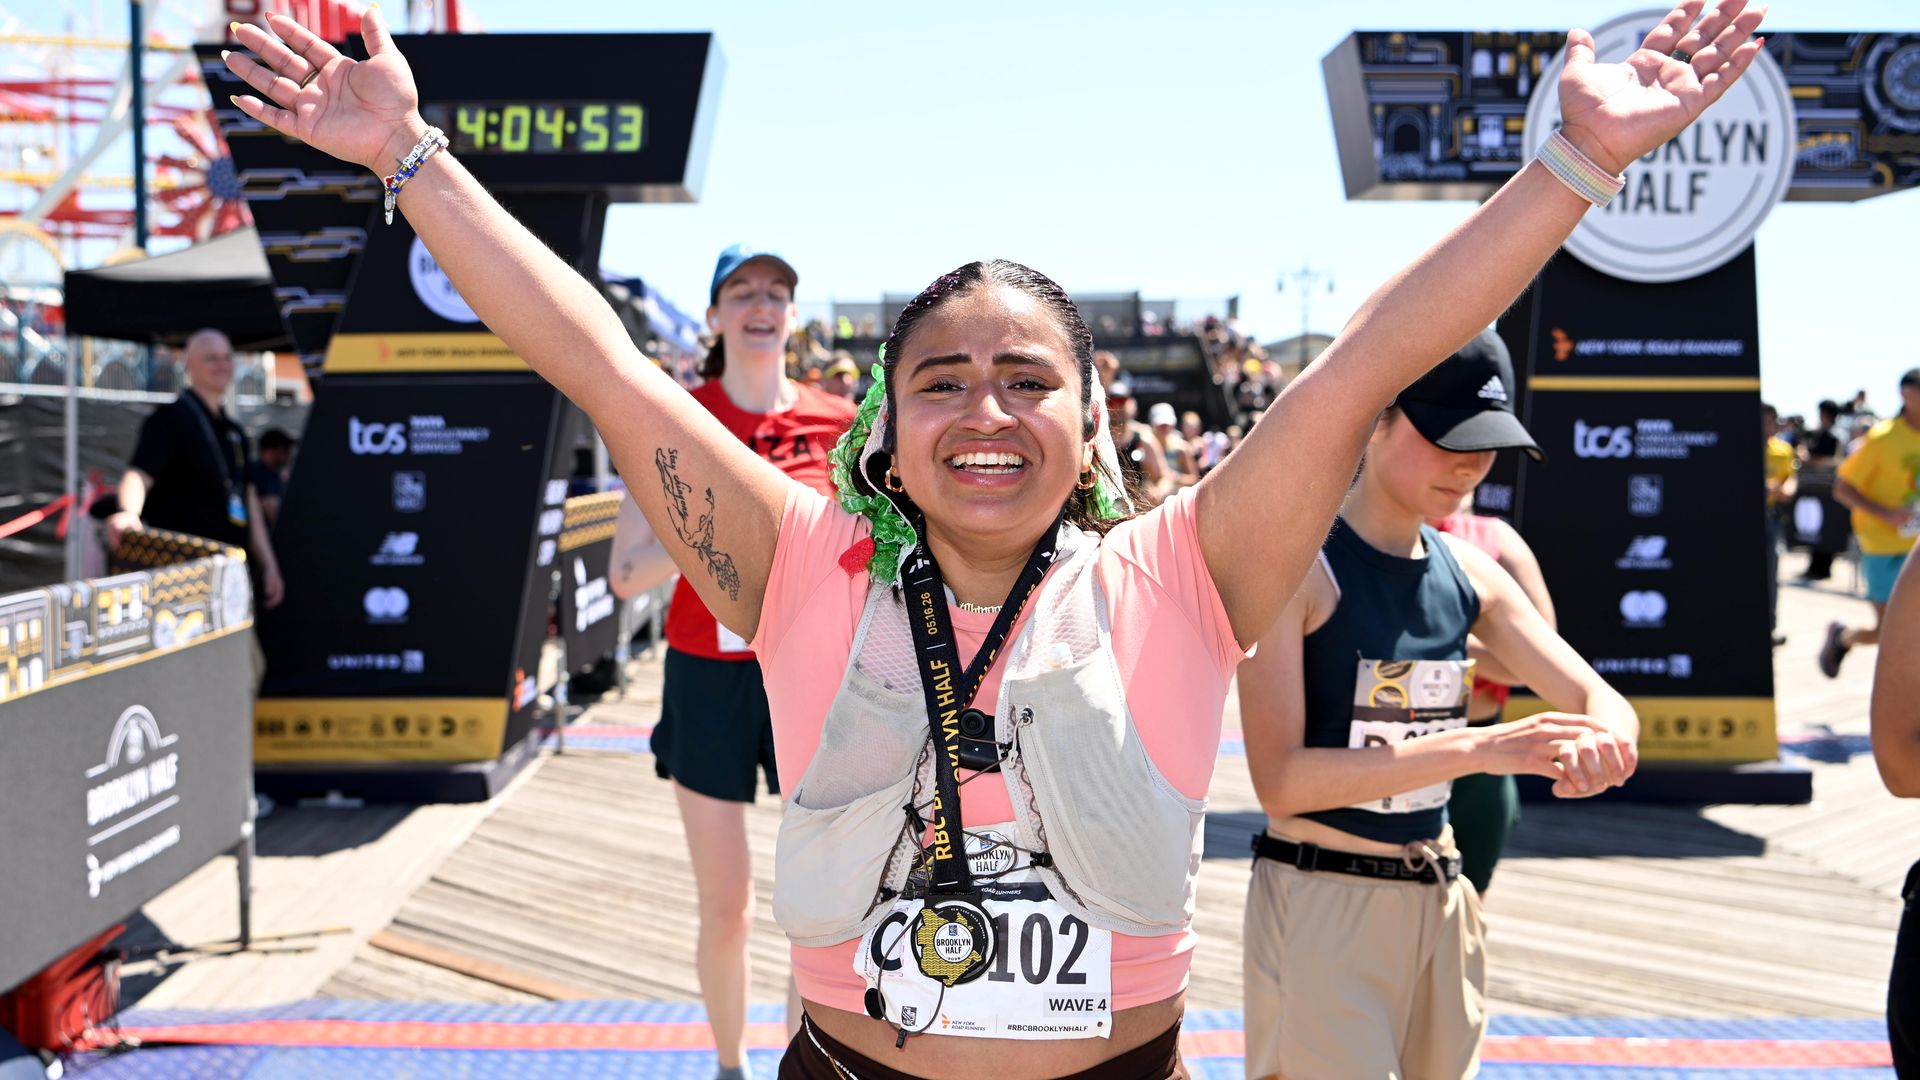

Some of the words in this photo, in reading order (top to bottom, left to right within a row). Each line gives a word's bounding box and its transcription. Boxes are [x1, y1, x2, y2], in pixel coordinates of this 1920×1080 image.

[350, 417, 407, 454] tcs
[1574, 419, 1633, 458] tcs
[921, 592, 937, 635] 05.16.26
[930, 659, 956, 708] HALF
[935, 816, 953, 861] RBC
[976, 860, 999, 872] HALF
[871, 911, 908, 971] C
[987, 912, 1090, 985] 102
[936, 938, 971, 947] BROOKLYN
[1049, 999, 1094, 1012] WAVE
[1097, 999, 1107, 1012] 4
[1007, 1023, 1088, 1032] #RBCBROOKLYNHALF
